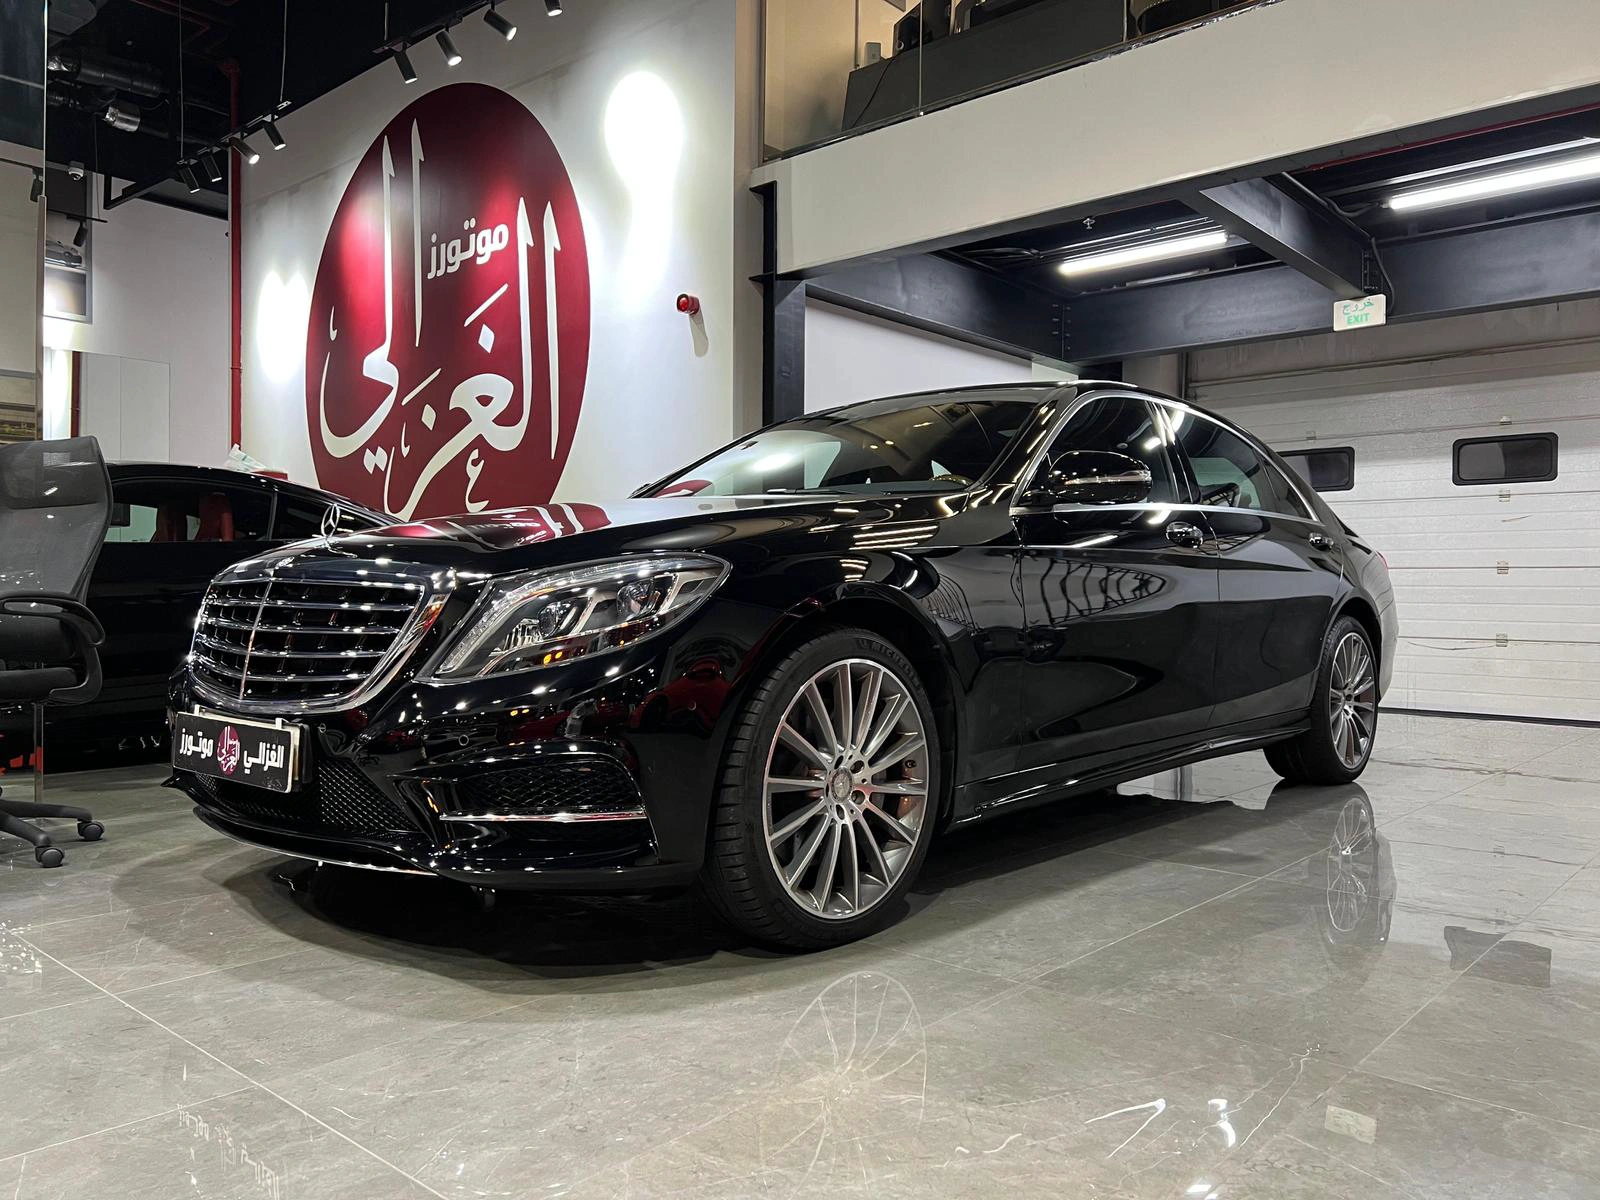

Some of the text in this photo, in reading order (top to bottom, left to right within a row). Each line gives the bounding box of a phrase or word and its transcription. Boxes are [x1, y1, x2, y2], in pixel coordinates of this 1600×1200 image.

[427, 217, 510, 280] موتورز
[1342, 297, 1375, 316] خروج
[1346, 312, 1372, 326] EXIT
[179, 727, 285, 775] الغزالي موتورز
